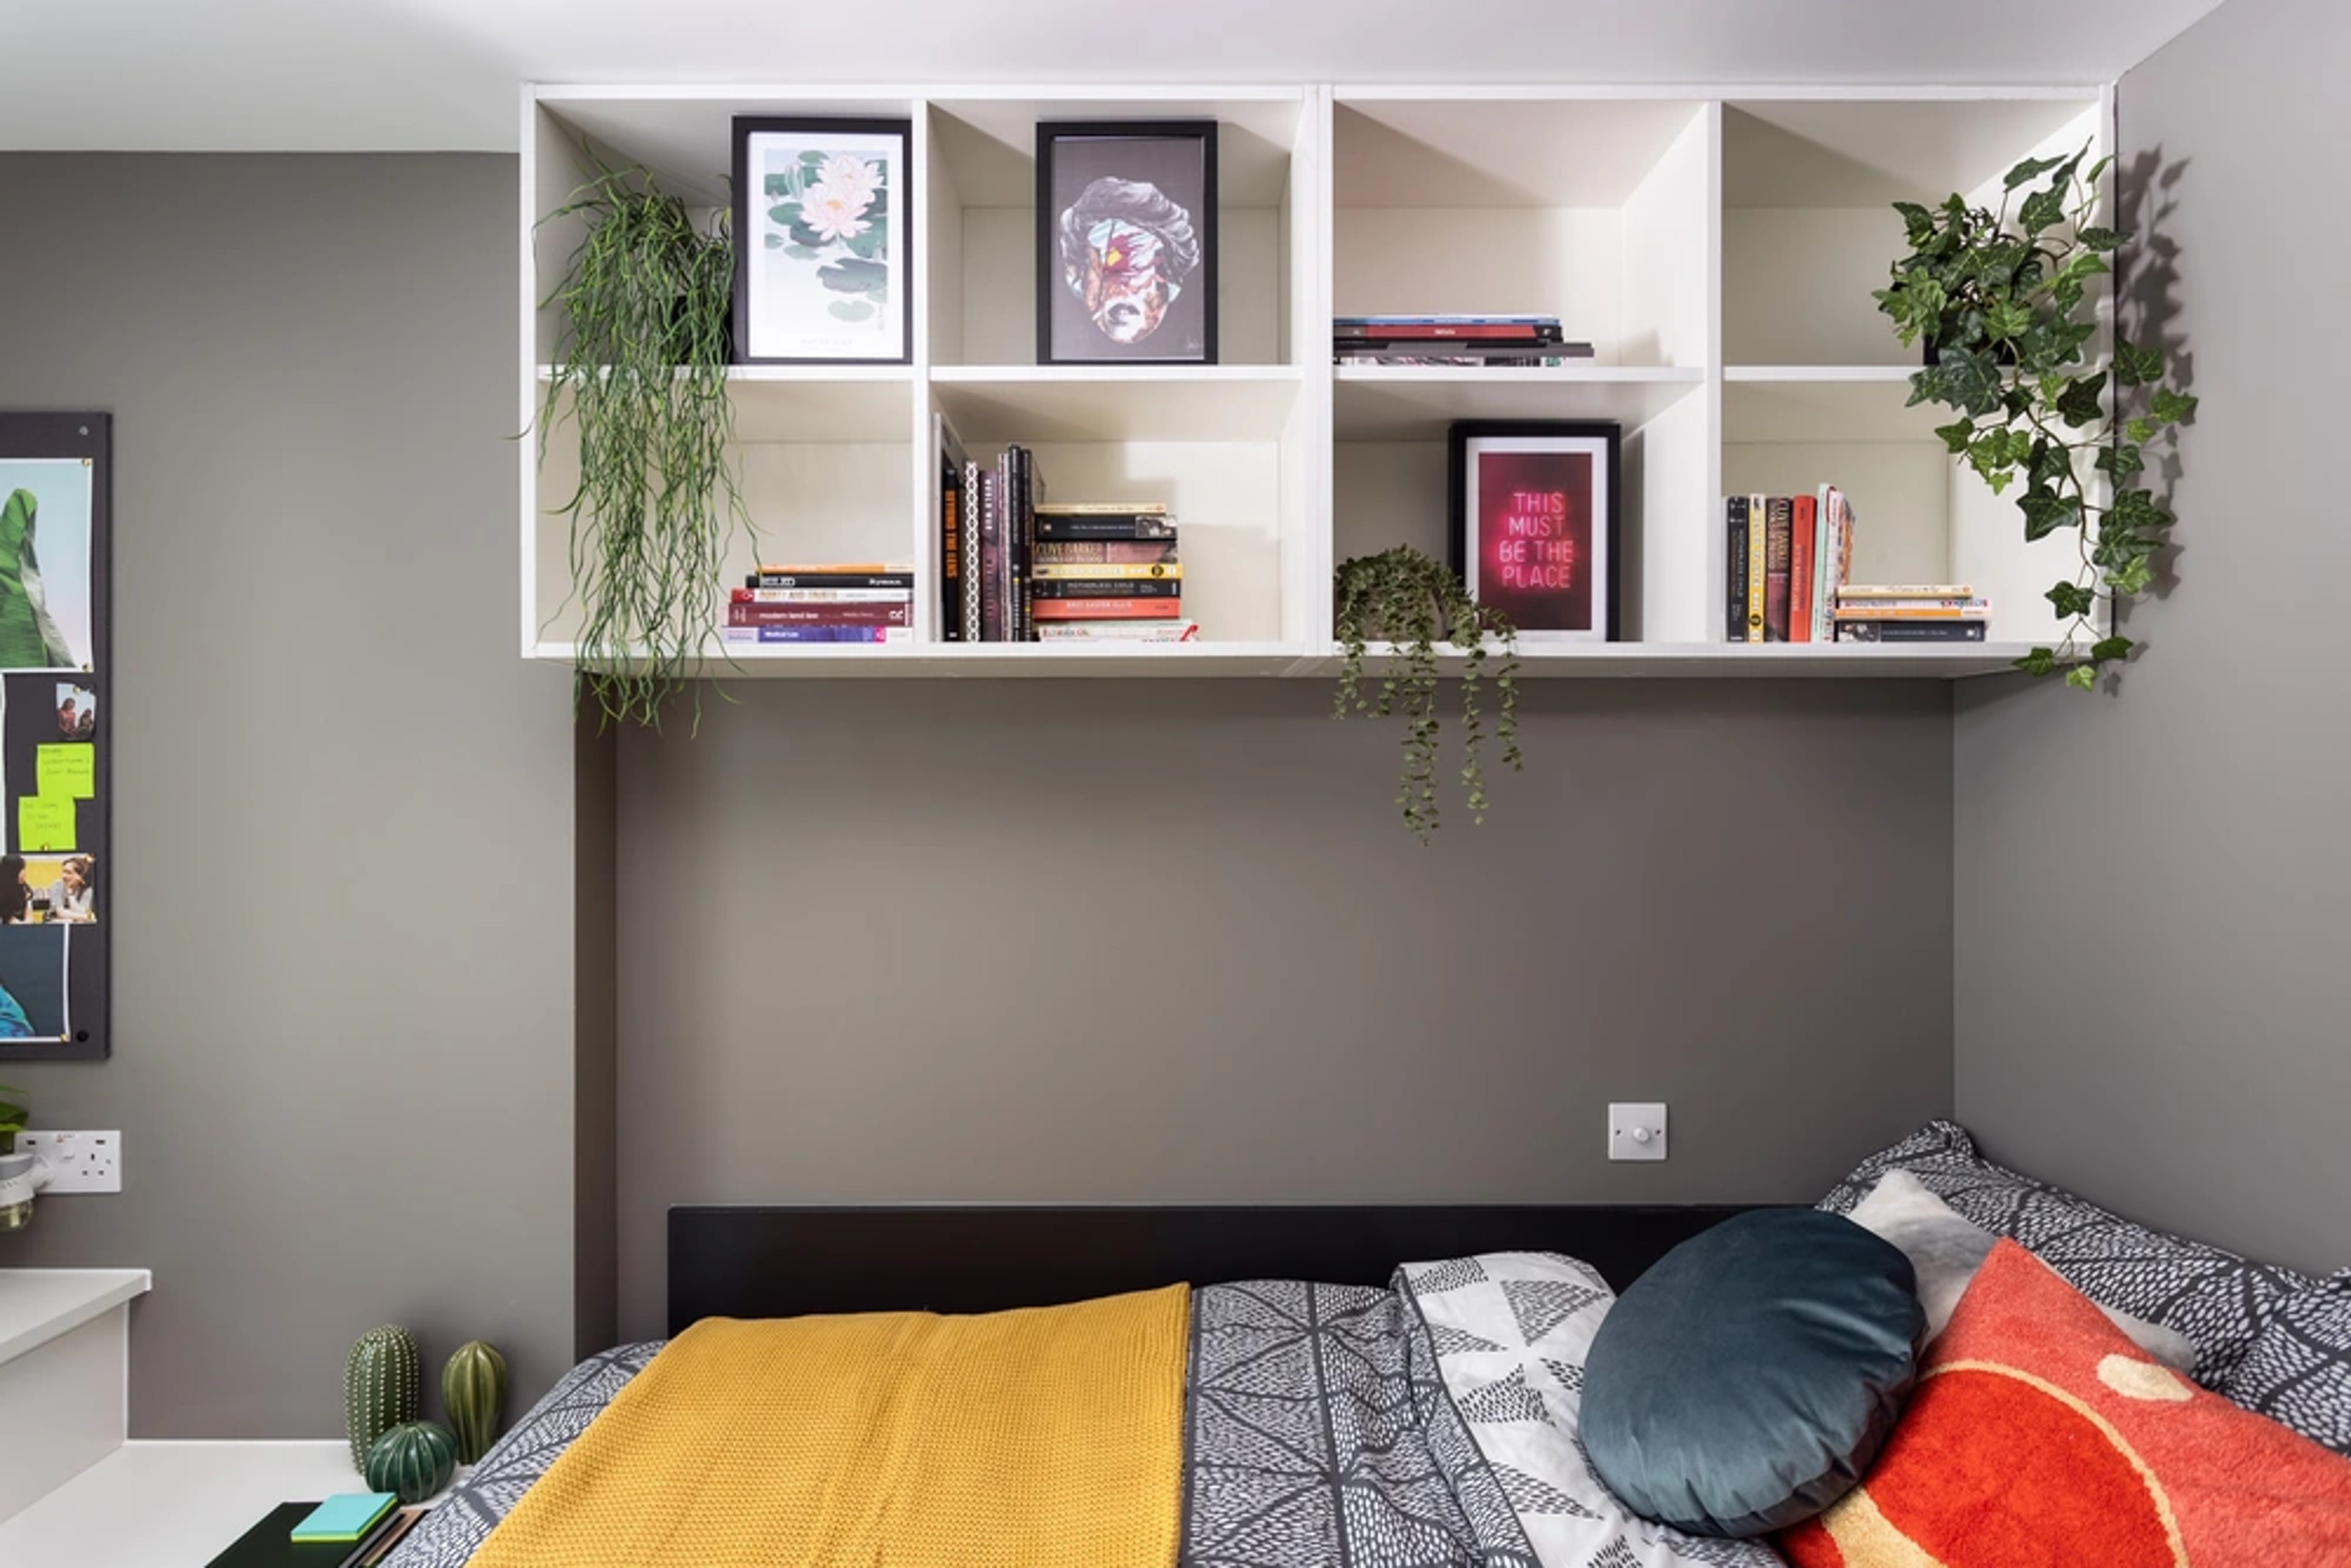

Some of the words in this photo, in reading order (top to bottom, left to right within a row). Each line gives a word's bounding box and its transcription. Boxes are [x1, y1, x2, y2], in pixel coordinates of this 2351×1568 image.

[1513, 492, 1564, 513] THIS
[1508, 515, 1564, 536] MUST
[1499, 540, 1526, 563] BE
[1533, 540, 1574, 563] THE
[1501, 566, 1572, 588] PLACE
